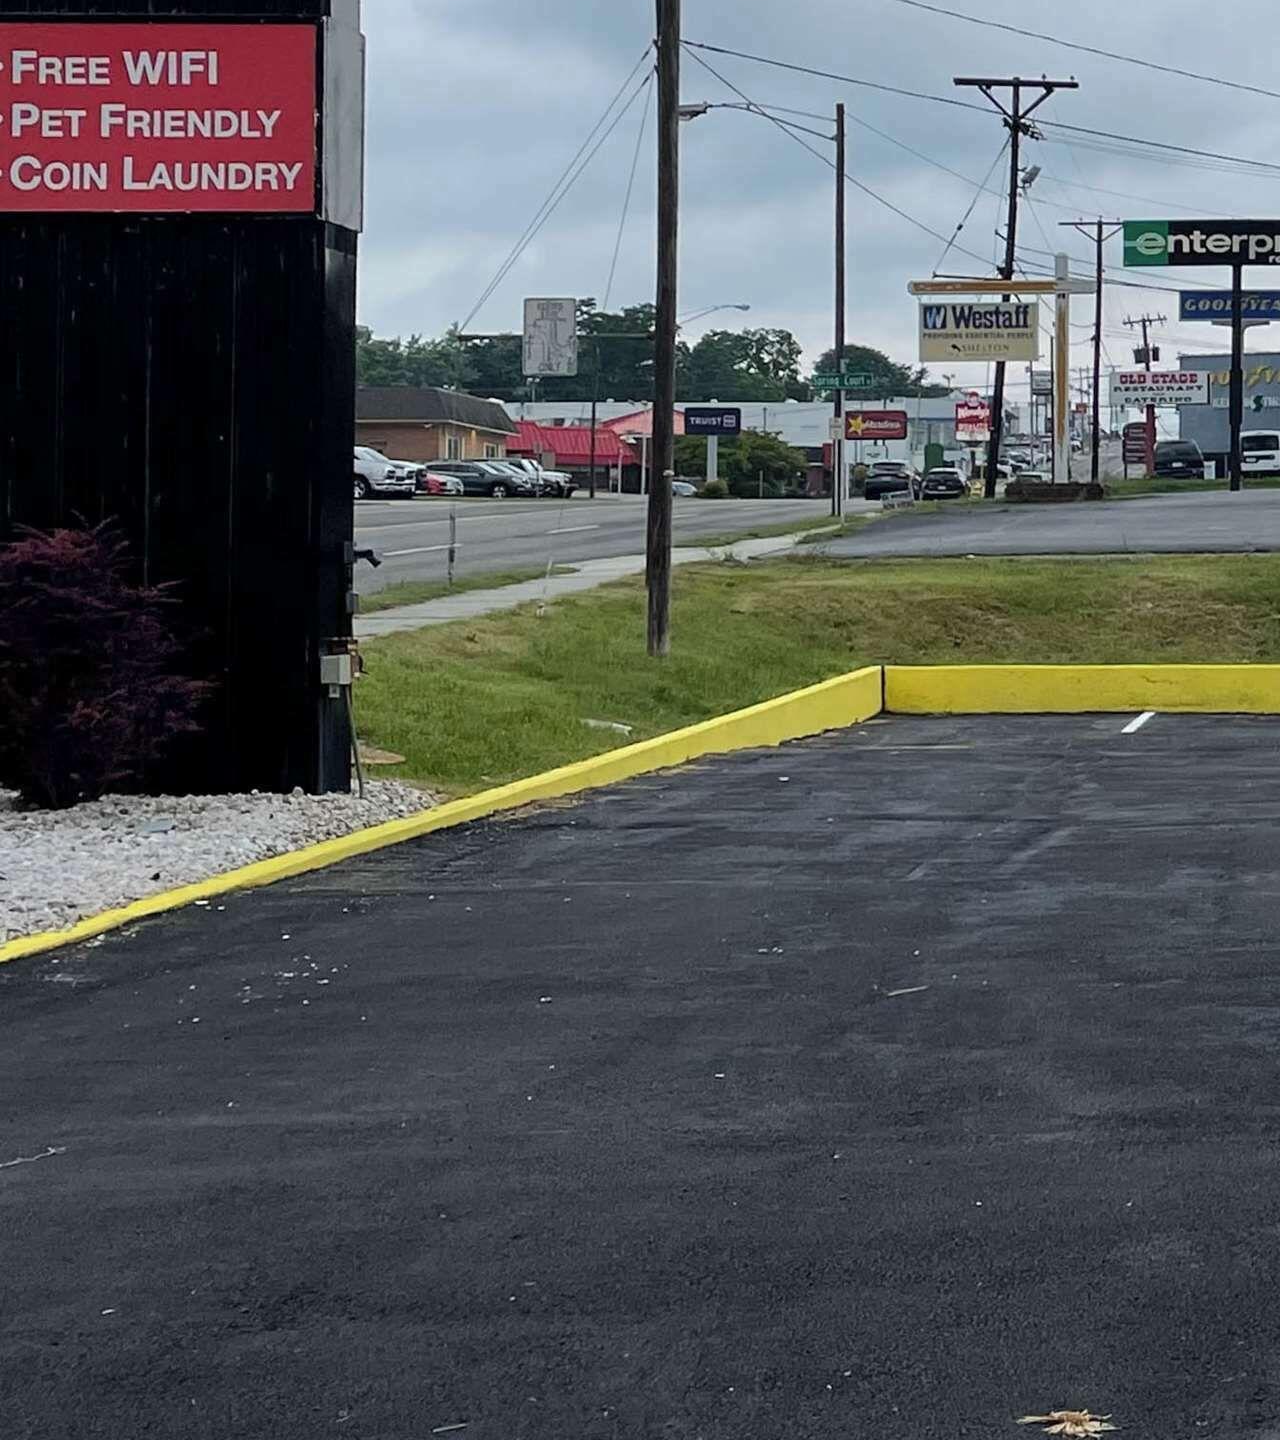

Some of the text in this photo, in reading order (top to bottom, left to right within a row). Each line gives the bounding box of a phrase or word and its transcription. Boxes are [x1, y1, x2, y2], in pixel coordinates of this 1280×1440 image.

[122, 50, 219, 85] WIFI
[951, 304, 1030, 330] Westaff
[814, 375, 840, 388] Spring
[843, 374, 865, 386] Court
[1119, 372, 1198, 385] OLD STAGE
[1113, 385, 1204, 393] RESTAURANT
[1124, 396, 1193, 404] CATERING
[689, 416, 722, 426] TRUIST
